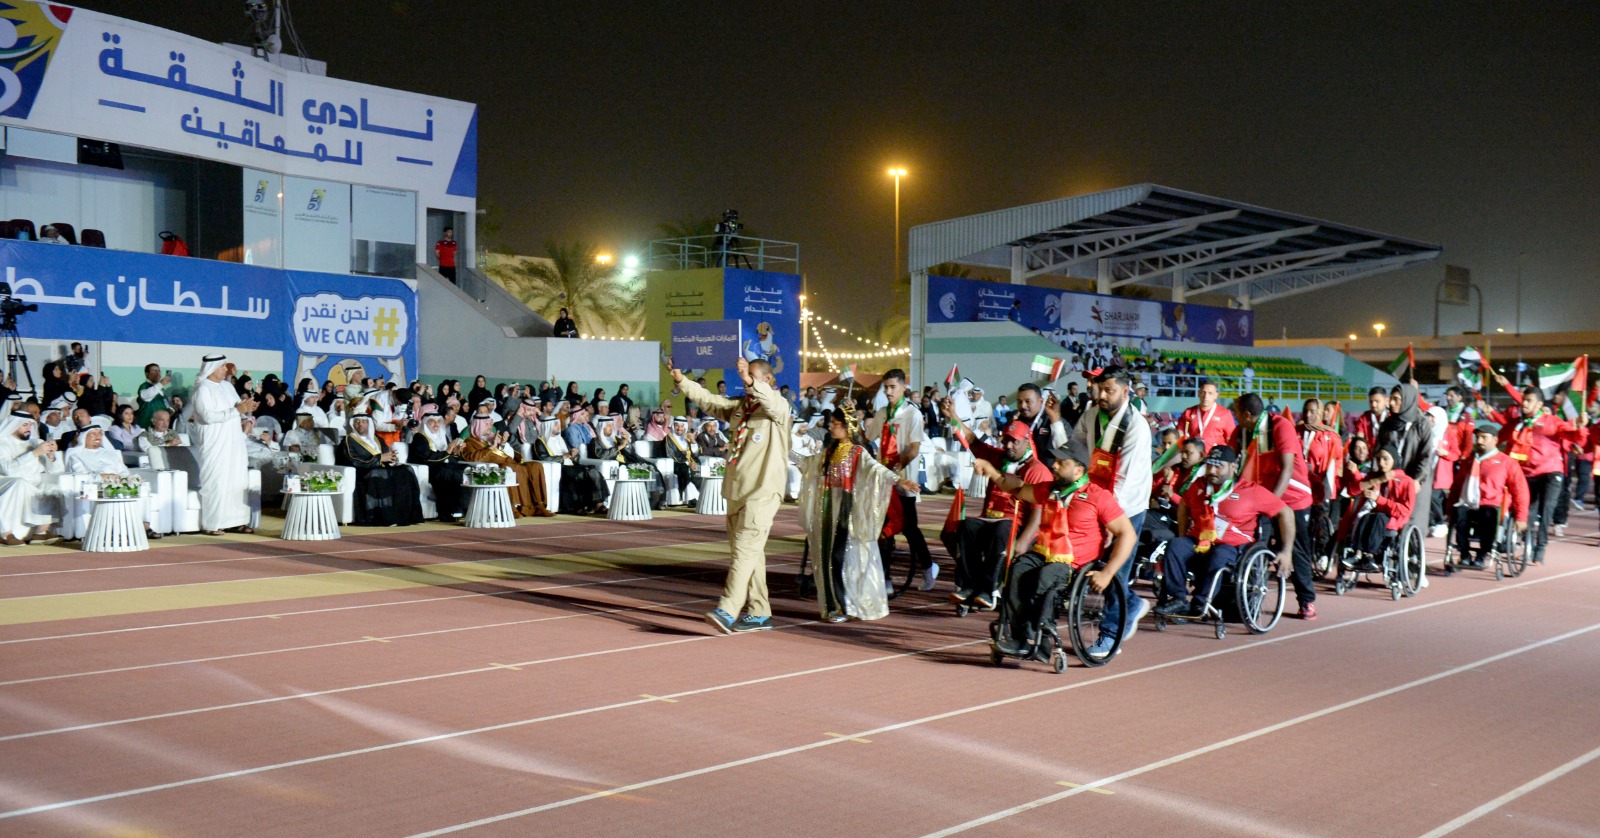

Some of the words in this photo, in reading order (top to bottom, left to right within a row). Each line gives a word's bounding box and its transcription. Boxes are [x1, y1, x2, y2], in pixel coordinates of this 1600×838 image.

[98, 31, 284, 117] الثقة
[302, 98, 433, 142] نادي
[180, 106, 363, 166] للمعاقين
[106, 275, 270, 320] سلطان
[744, 285, 783, 295] سلطان
[744, 295, 783, 305] عطاء
[302, 303, 337, 322] نقدر
[341, 306, 369, 324] نحن
[744, 305, 783, 315] مستدام
[302, 327, 330, 344] WE
[334, 329, 369, 346] CAN
[696, 345, 713, 356] UAE
